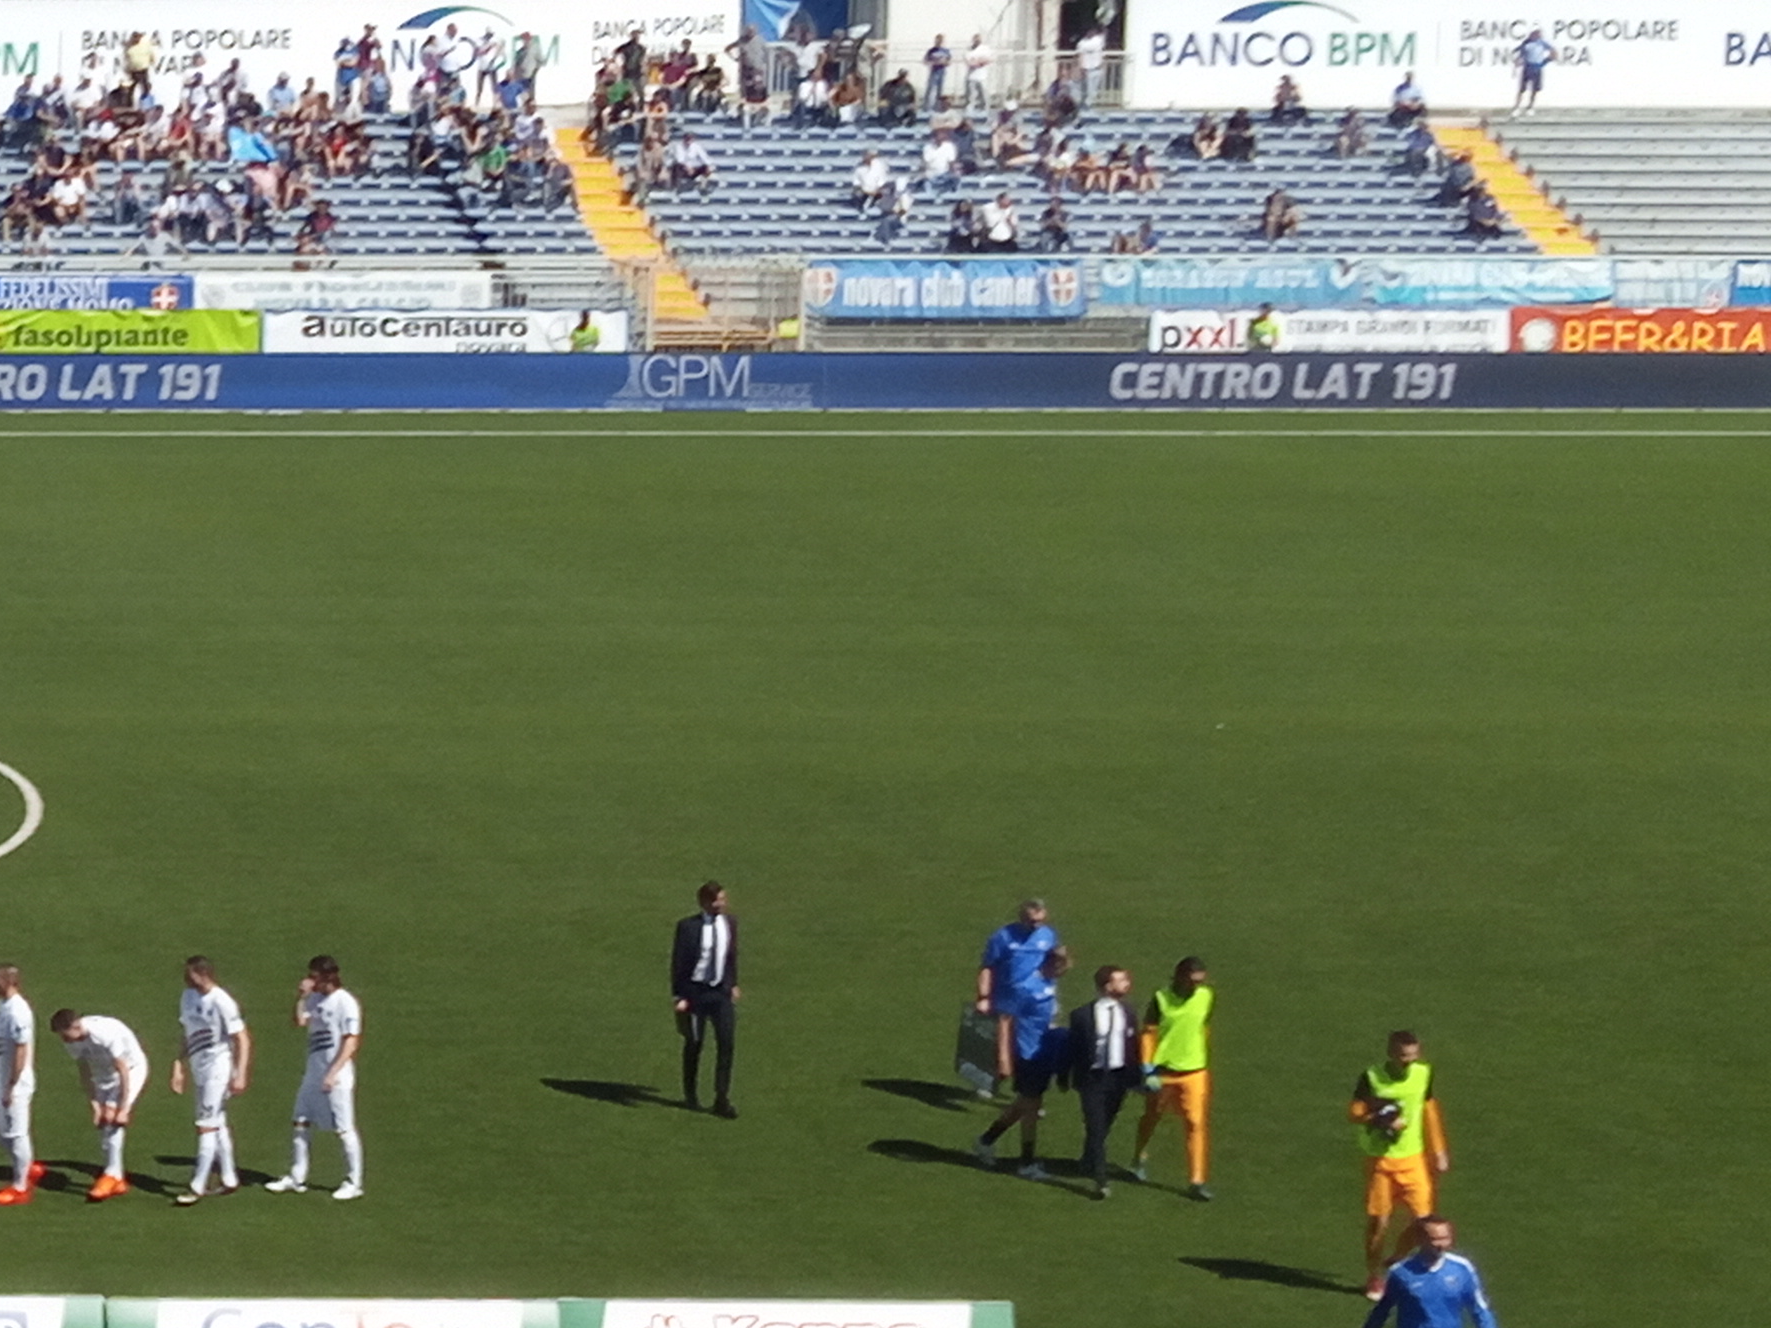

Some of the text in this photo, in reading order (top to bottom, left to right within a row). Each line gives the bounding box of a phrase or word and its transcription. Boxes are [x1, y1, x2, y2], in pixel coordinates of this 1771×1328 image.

[80, 28, 292, 51] BANA POPOLARE
[1458, 19, 1679, 41] BANC POPOLARE
[1149, 32, 1416, 68] BANCO BPM
[1458, 45, 1483, 68] DI
[58, 364, 147, 403] LAT
[158, 364, 223, 403] 191
[641, 354, 752, 398] GPM
[1109, 362, 1458, 401] CENTRO LAT 191
